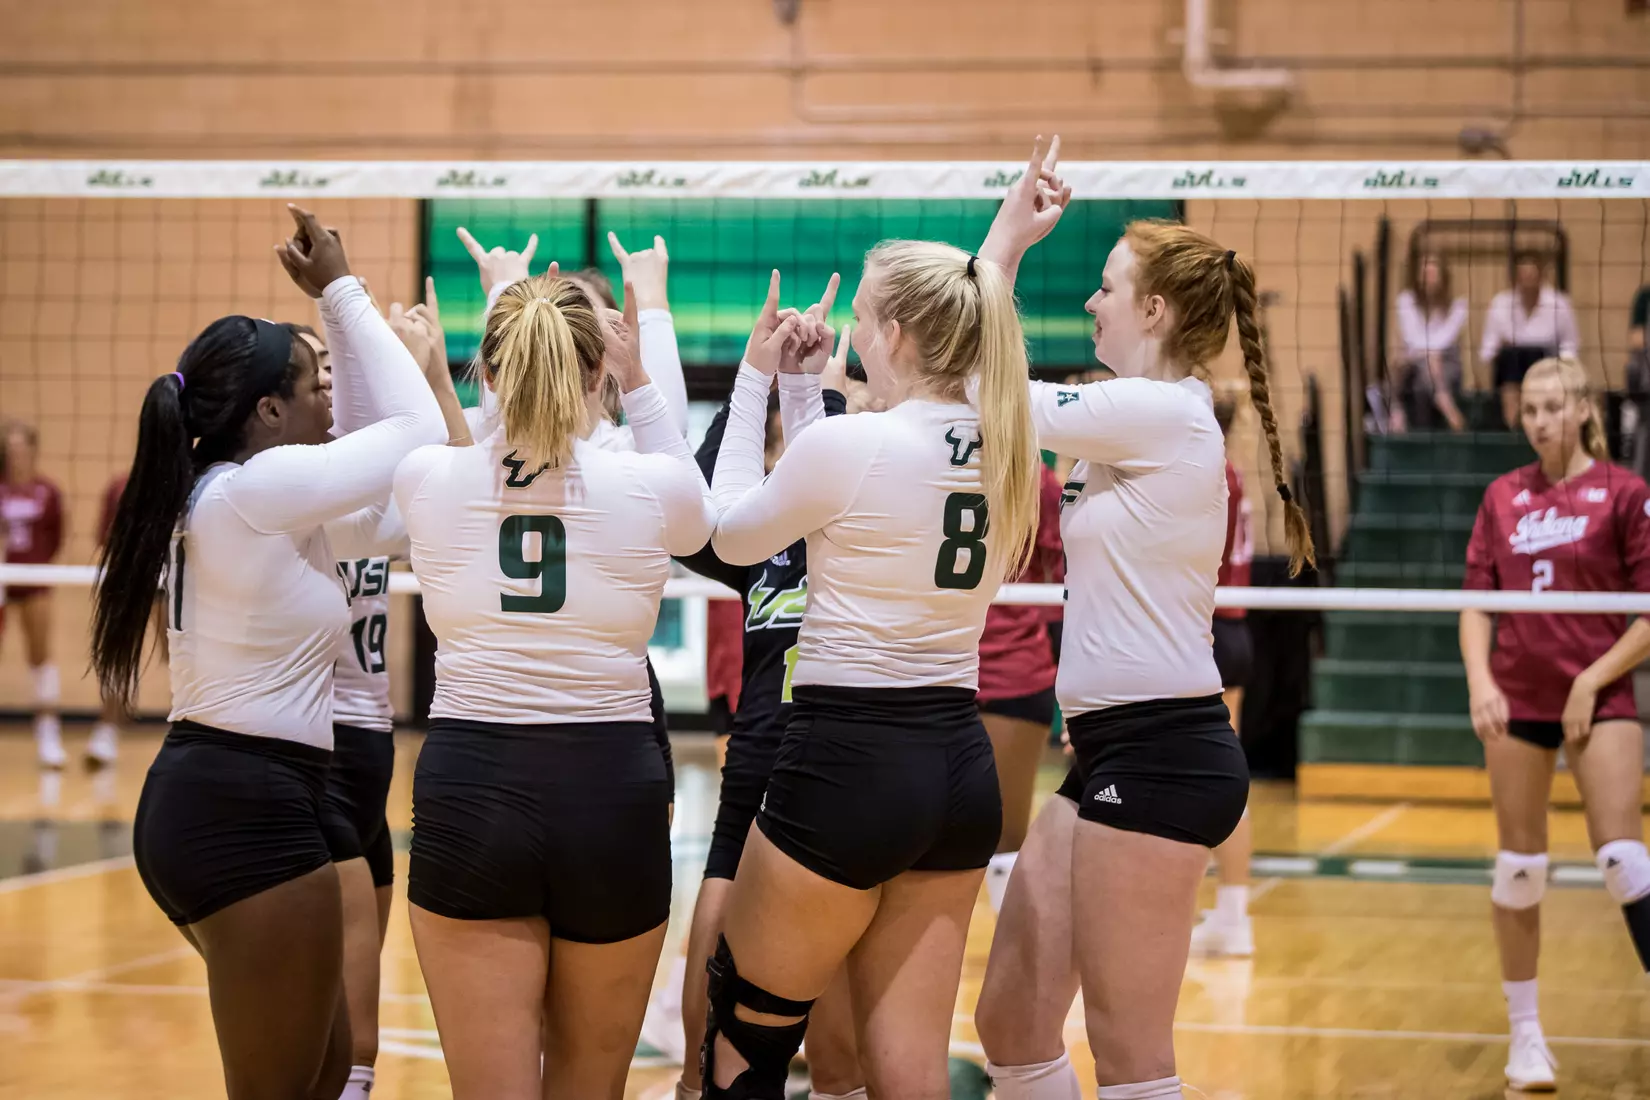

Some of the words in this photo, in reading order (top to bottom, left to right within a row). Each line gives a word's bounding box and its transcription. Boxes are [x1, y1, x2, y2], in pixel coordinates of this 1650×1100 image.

[499, 515, 567, 614] 9
[935, 492, 990, 590] 8
[350, 614, 387, 674] 19
[1094, 794, 1122, 805] adidas
